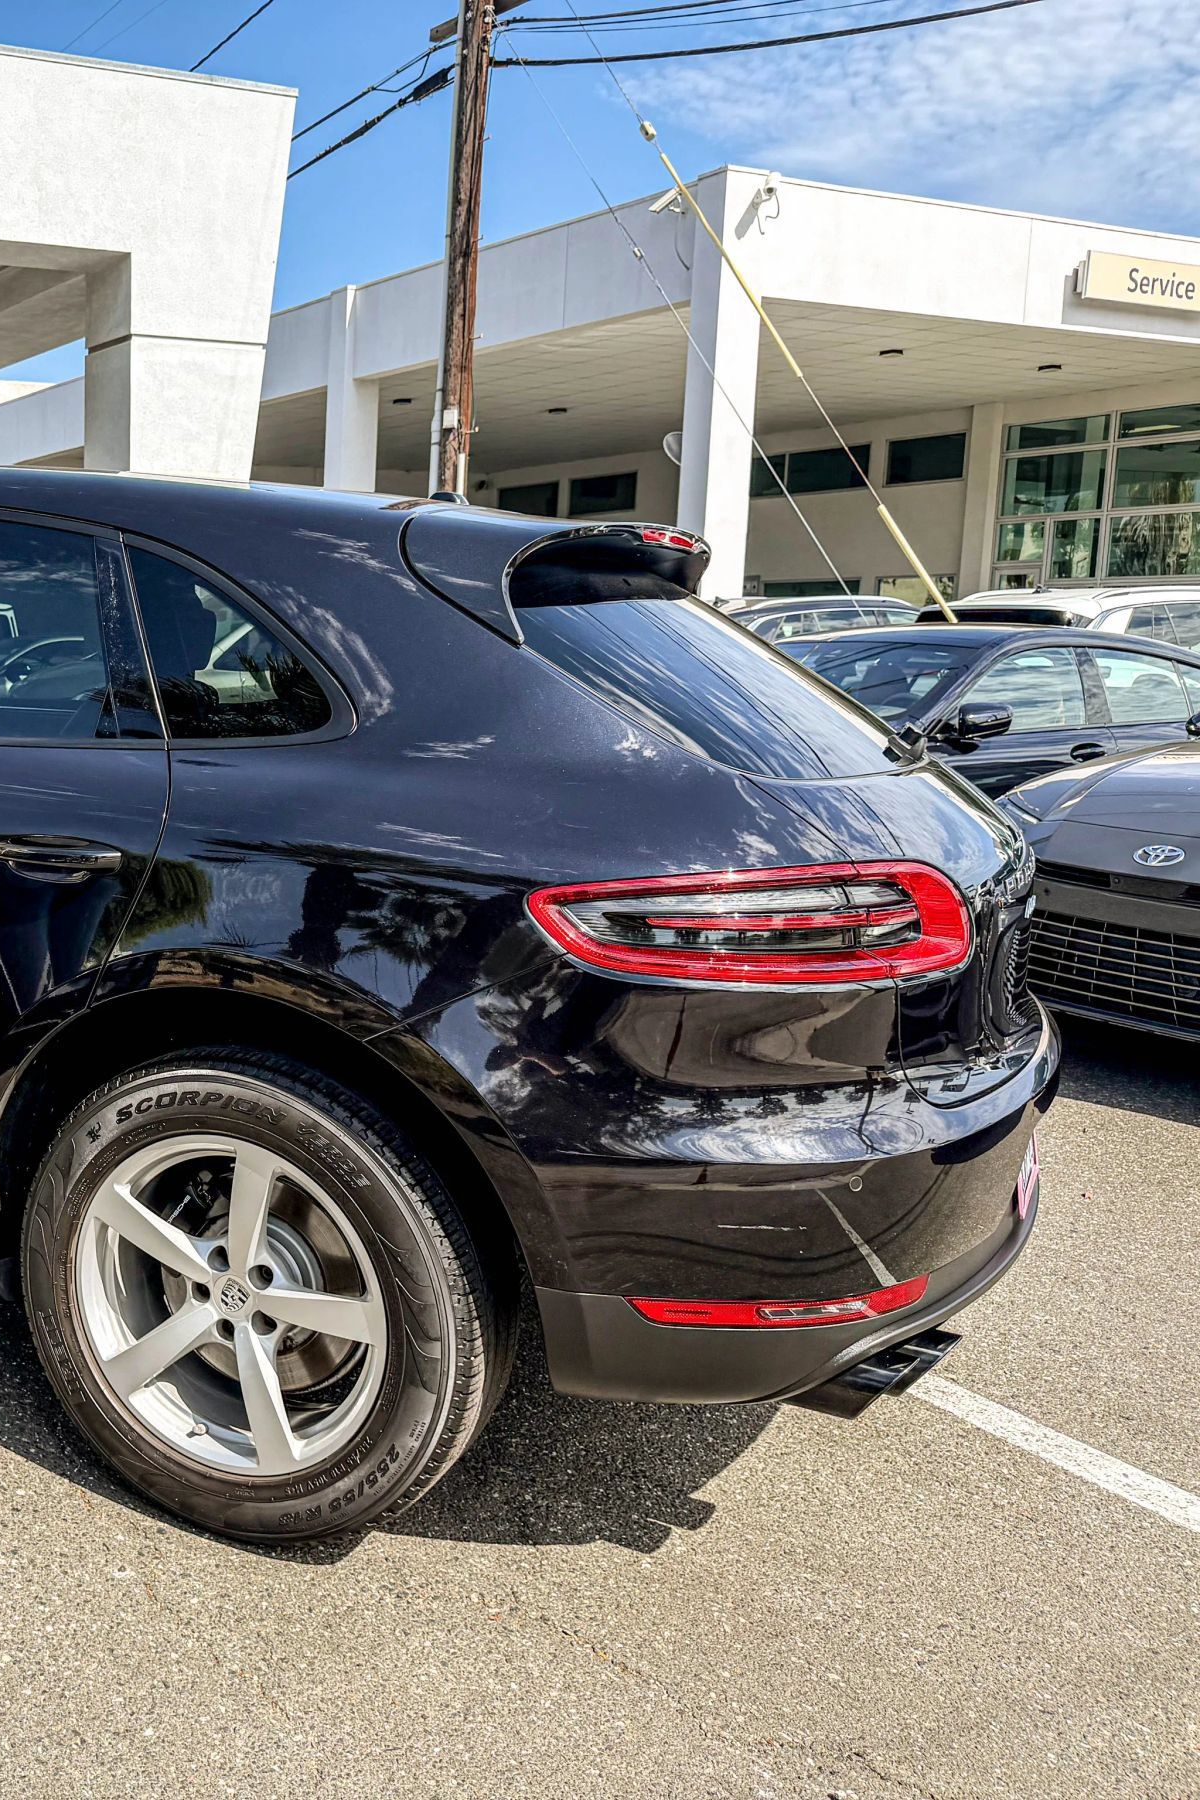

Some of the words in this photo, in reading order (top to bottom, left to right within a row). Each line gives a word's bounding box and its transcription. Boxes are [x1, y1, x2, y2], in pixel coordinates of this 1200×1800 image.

[1127, 267, 1196, 300] Service
[115, 1090, 288, 1126] SCORPION
[166, 1194, 192, 1224] ORSCHE
[328, 1442, 400, 1514] 255/55
